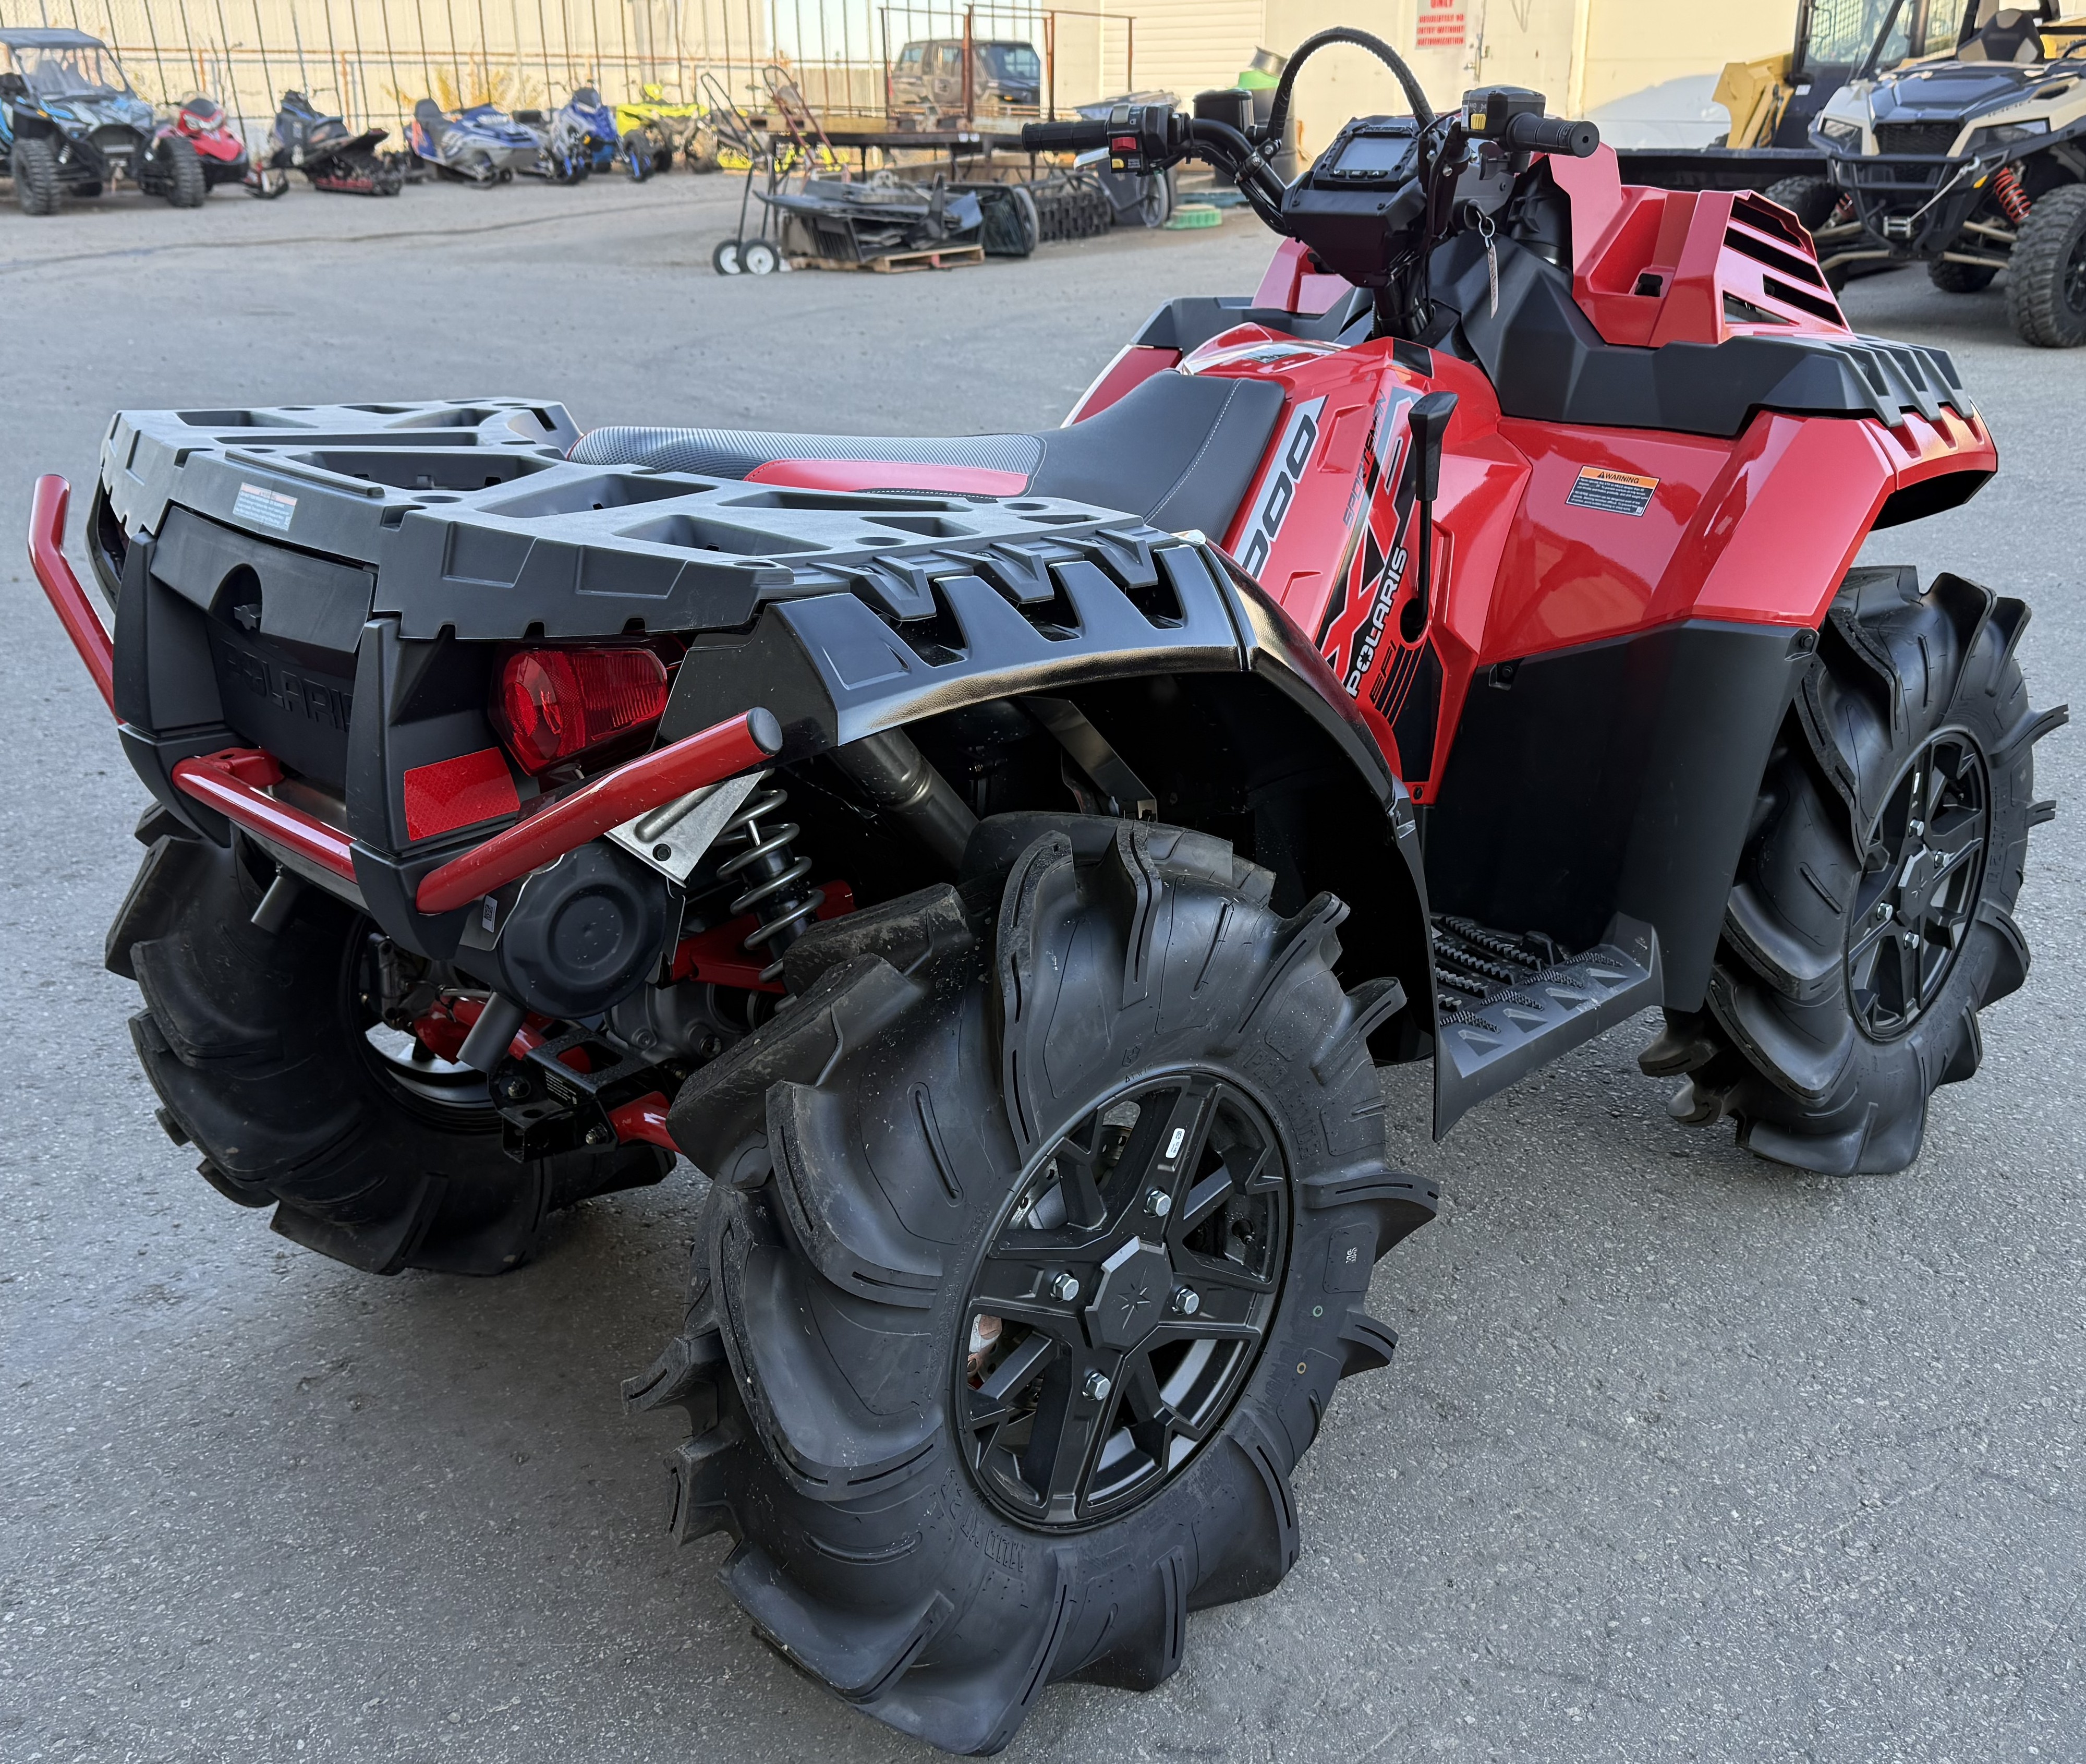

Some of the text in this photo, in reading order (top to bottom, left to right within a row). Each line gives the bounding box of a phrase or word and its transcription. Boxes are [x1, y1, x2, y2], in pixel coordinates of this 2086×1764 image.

[1605, 473, 1640, 484] WARNING
[1345, 547, 1408, 698] POLARIS
[219, 637, 354, 733] POLARI
